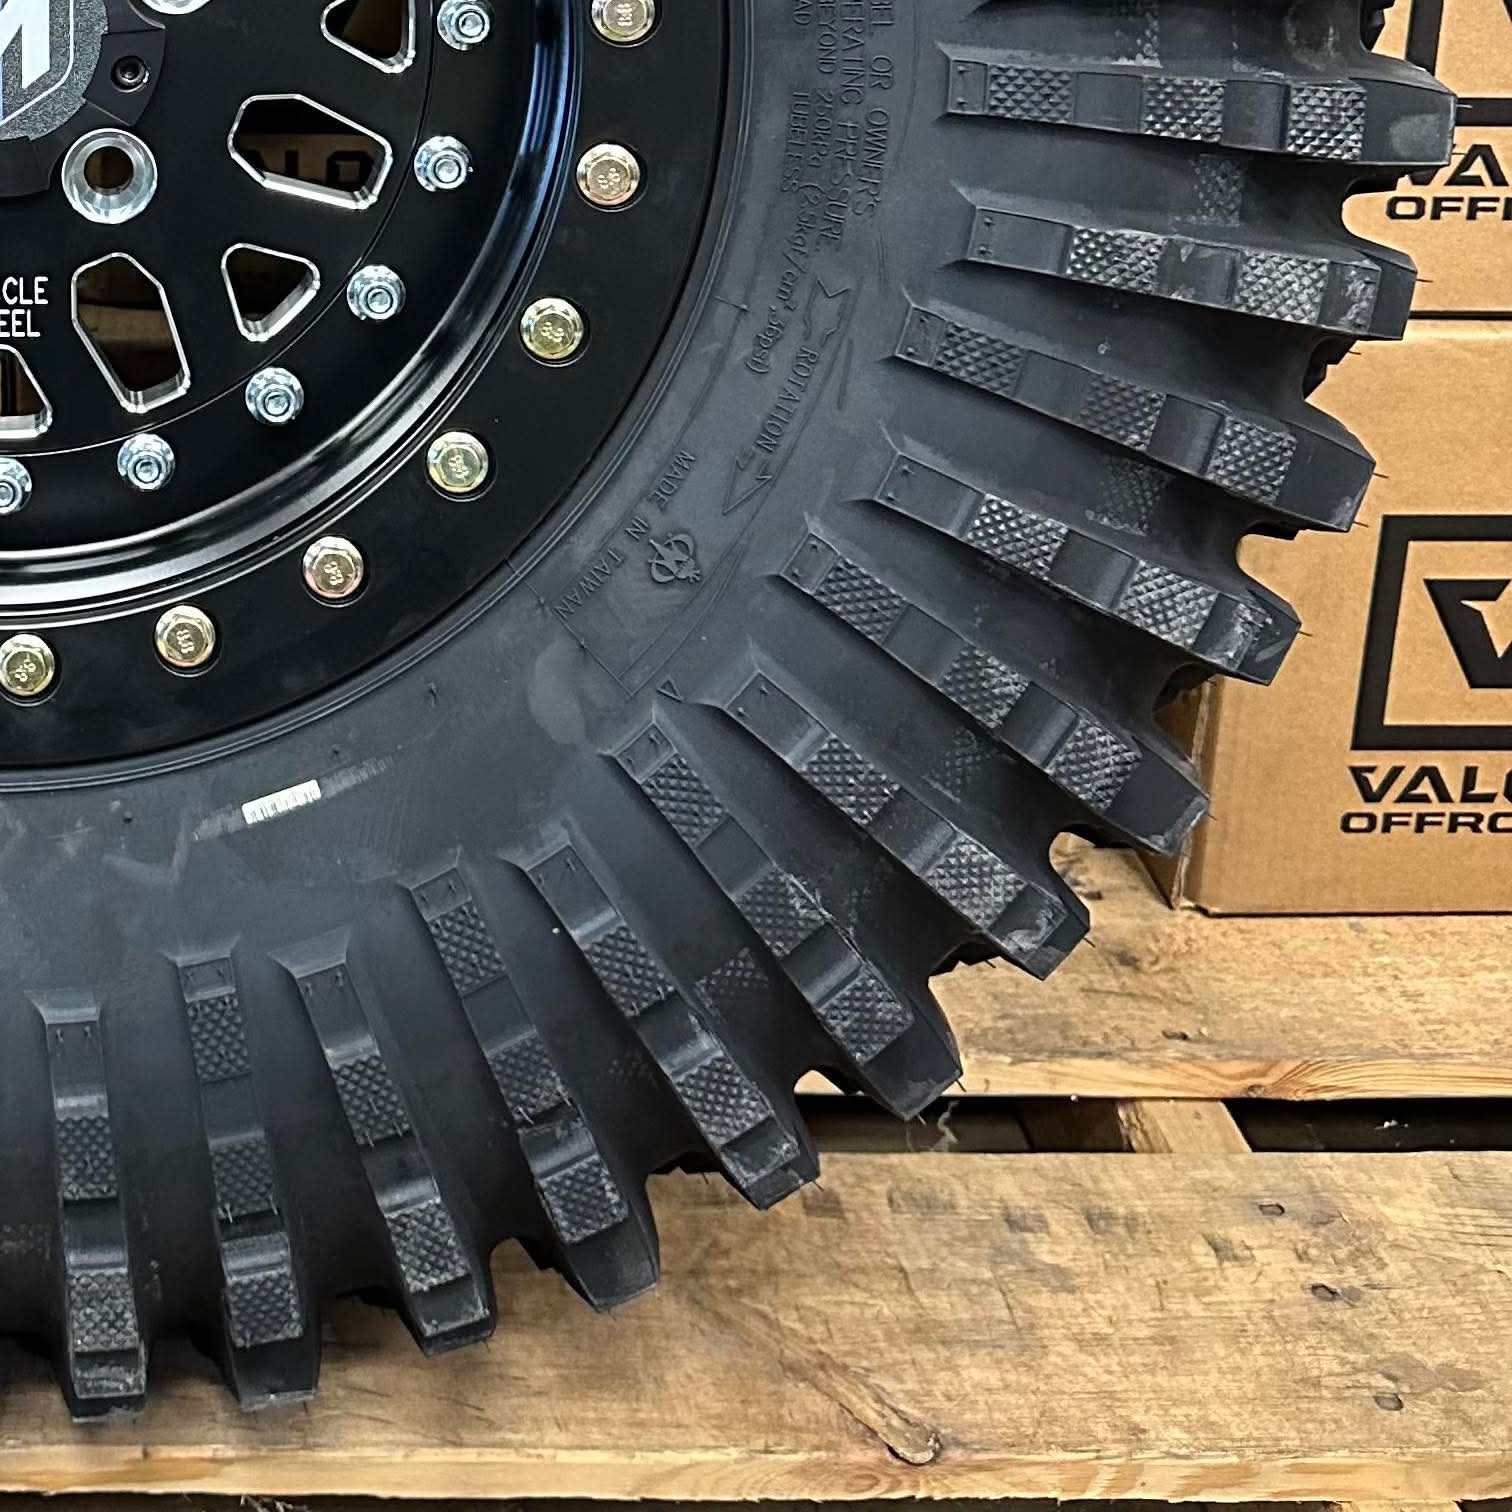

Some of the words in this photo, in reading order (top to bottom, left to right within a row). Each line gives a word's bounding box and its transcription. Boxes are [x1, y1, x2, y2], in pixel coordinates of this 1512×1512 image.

[867, 53, 896, 91] OR
[1386, 196, 1512, 221] OFF
[753, 345, 823, 455] ROTATION
[652, 449, 697, 508] MADE
[625, 516, 649, 541] IN
[555, 548, 625, 619] TAIWAN
[1348, 765, 1512, 803] VAL
